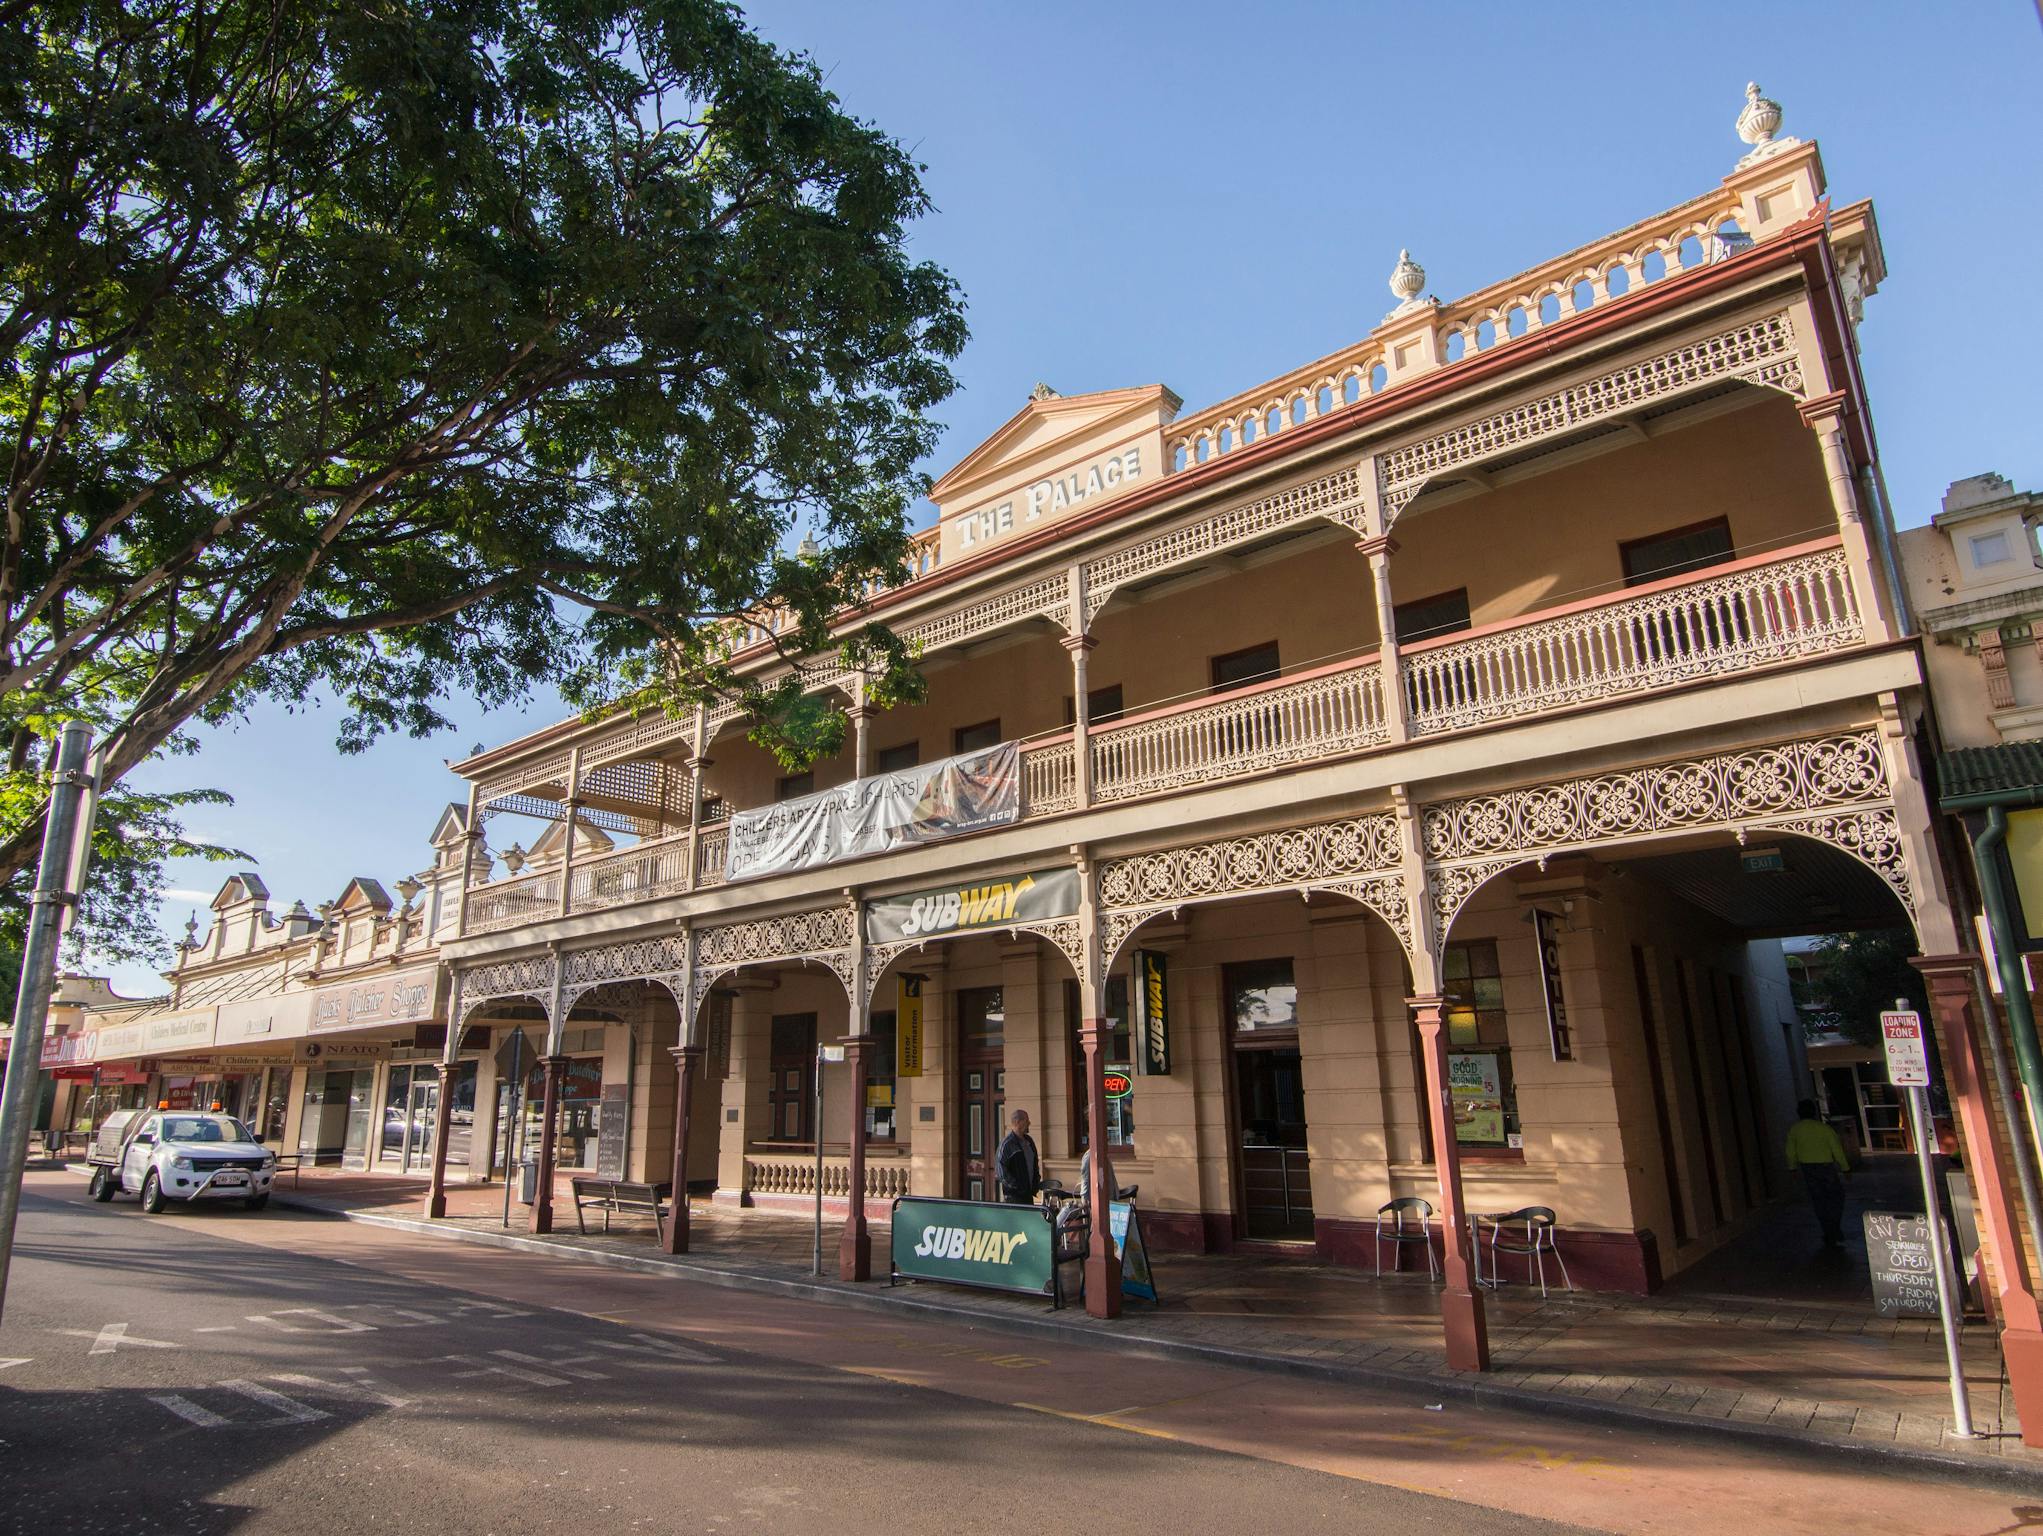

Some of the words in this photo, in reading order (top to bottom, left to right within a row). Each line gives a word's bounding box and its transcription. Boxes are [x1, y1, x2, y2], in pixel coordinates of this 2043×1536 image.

[955, 501, 1014, 549] THE
[1025, 447, 1142, 523] PALACE
[790, 805, 818, 825] ART
[731, 849, 768, 874] OPE
[900, 874, 1037, 937] SUBWAY
[347, 984, 385, 1024] Butcher
[390, 979, 429, 1019] Shoppe
[1147, 957, 1168, 1073] SUBWAY
[1883, 1016, 1917, 1027] LOADING
[1889, 1027, 1915, 1038] ZONE
[327, 1044, 380, 1056] NEATO
[225, 1055, 259, 1065] Childers
[262, 1055, 291, 1065] Medical
[1453, 1062, 1478, 1074] GOOD
[1104, 1078, 1127, 1091] PEN
[1449, 1075, 1482, 1086] MORNING
[913, 1224, 1028, 1266] SUBWAY
[1889, 1252, 1928, 1269] OPEN
[1875, 1271, 1935, 1288] THURSDAY
[1897, 1286, 1939, 1301] FRIDAY
[1880, 1298, 1934, 1312] SATURDAY
